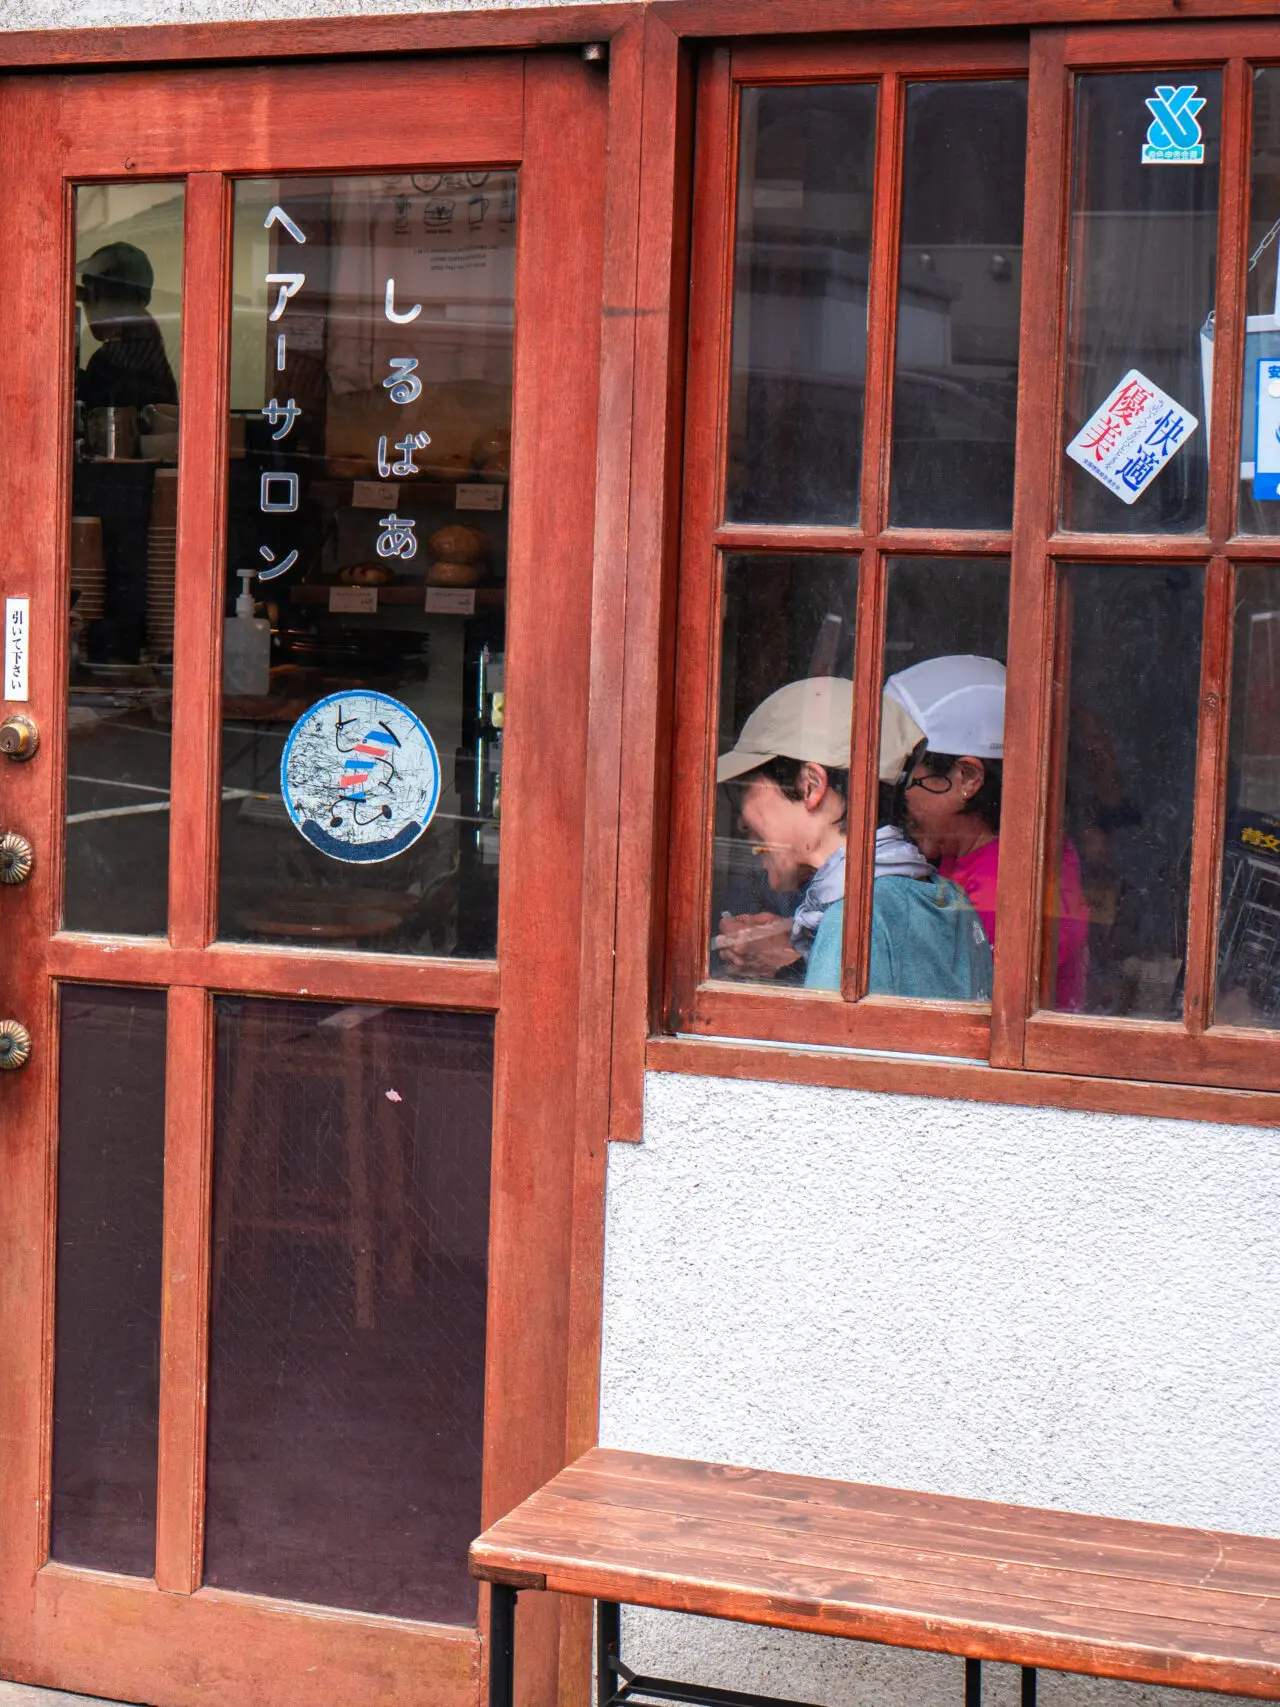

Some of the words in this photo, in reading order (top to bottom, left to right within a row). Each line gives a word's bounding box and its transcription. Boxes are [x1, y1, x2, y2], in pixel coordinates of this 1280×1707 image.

[258, 205, 306, 581] ヘアーサロン
[376, 278, 431, 559] しるばあ
[1079, 380, 1154, 462] 優美
[1115, 409, 1184, 492] 快適
[12, 611, 23, 690] 引いて下さい
